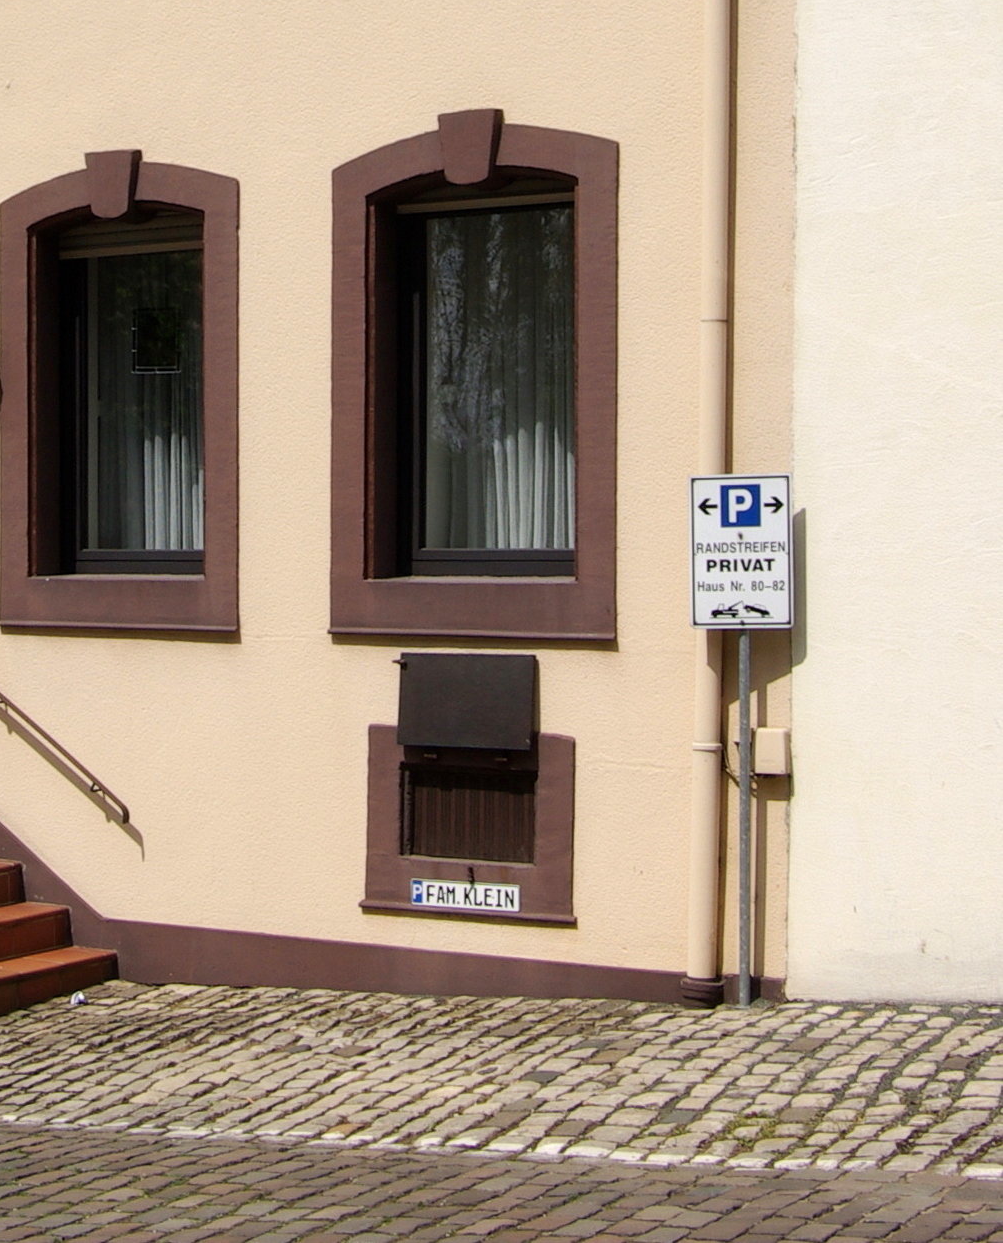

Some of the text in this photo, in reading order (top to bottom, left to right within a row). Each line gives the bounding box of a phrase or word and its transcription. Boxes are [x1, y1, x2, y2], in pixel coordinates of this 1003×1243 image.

[728, 488, 753, 524] P
[696, 541, 787, 554] RANDSTREIFEN
[706, 558, 776, 573] PRIVAT
[697, 581, 725, 592] Haus
[730, 580, 746, 592] Nr.
